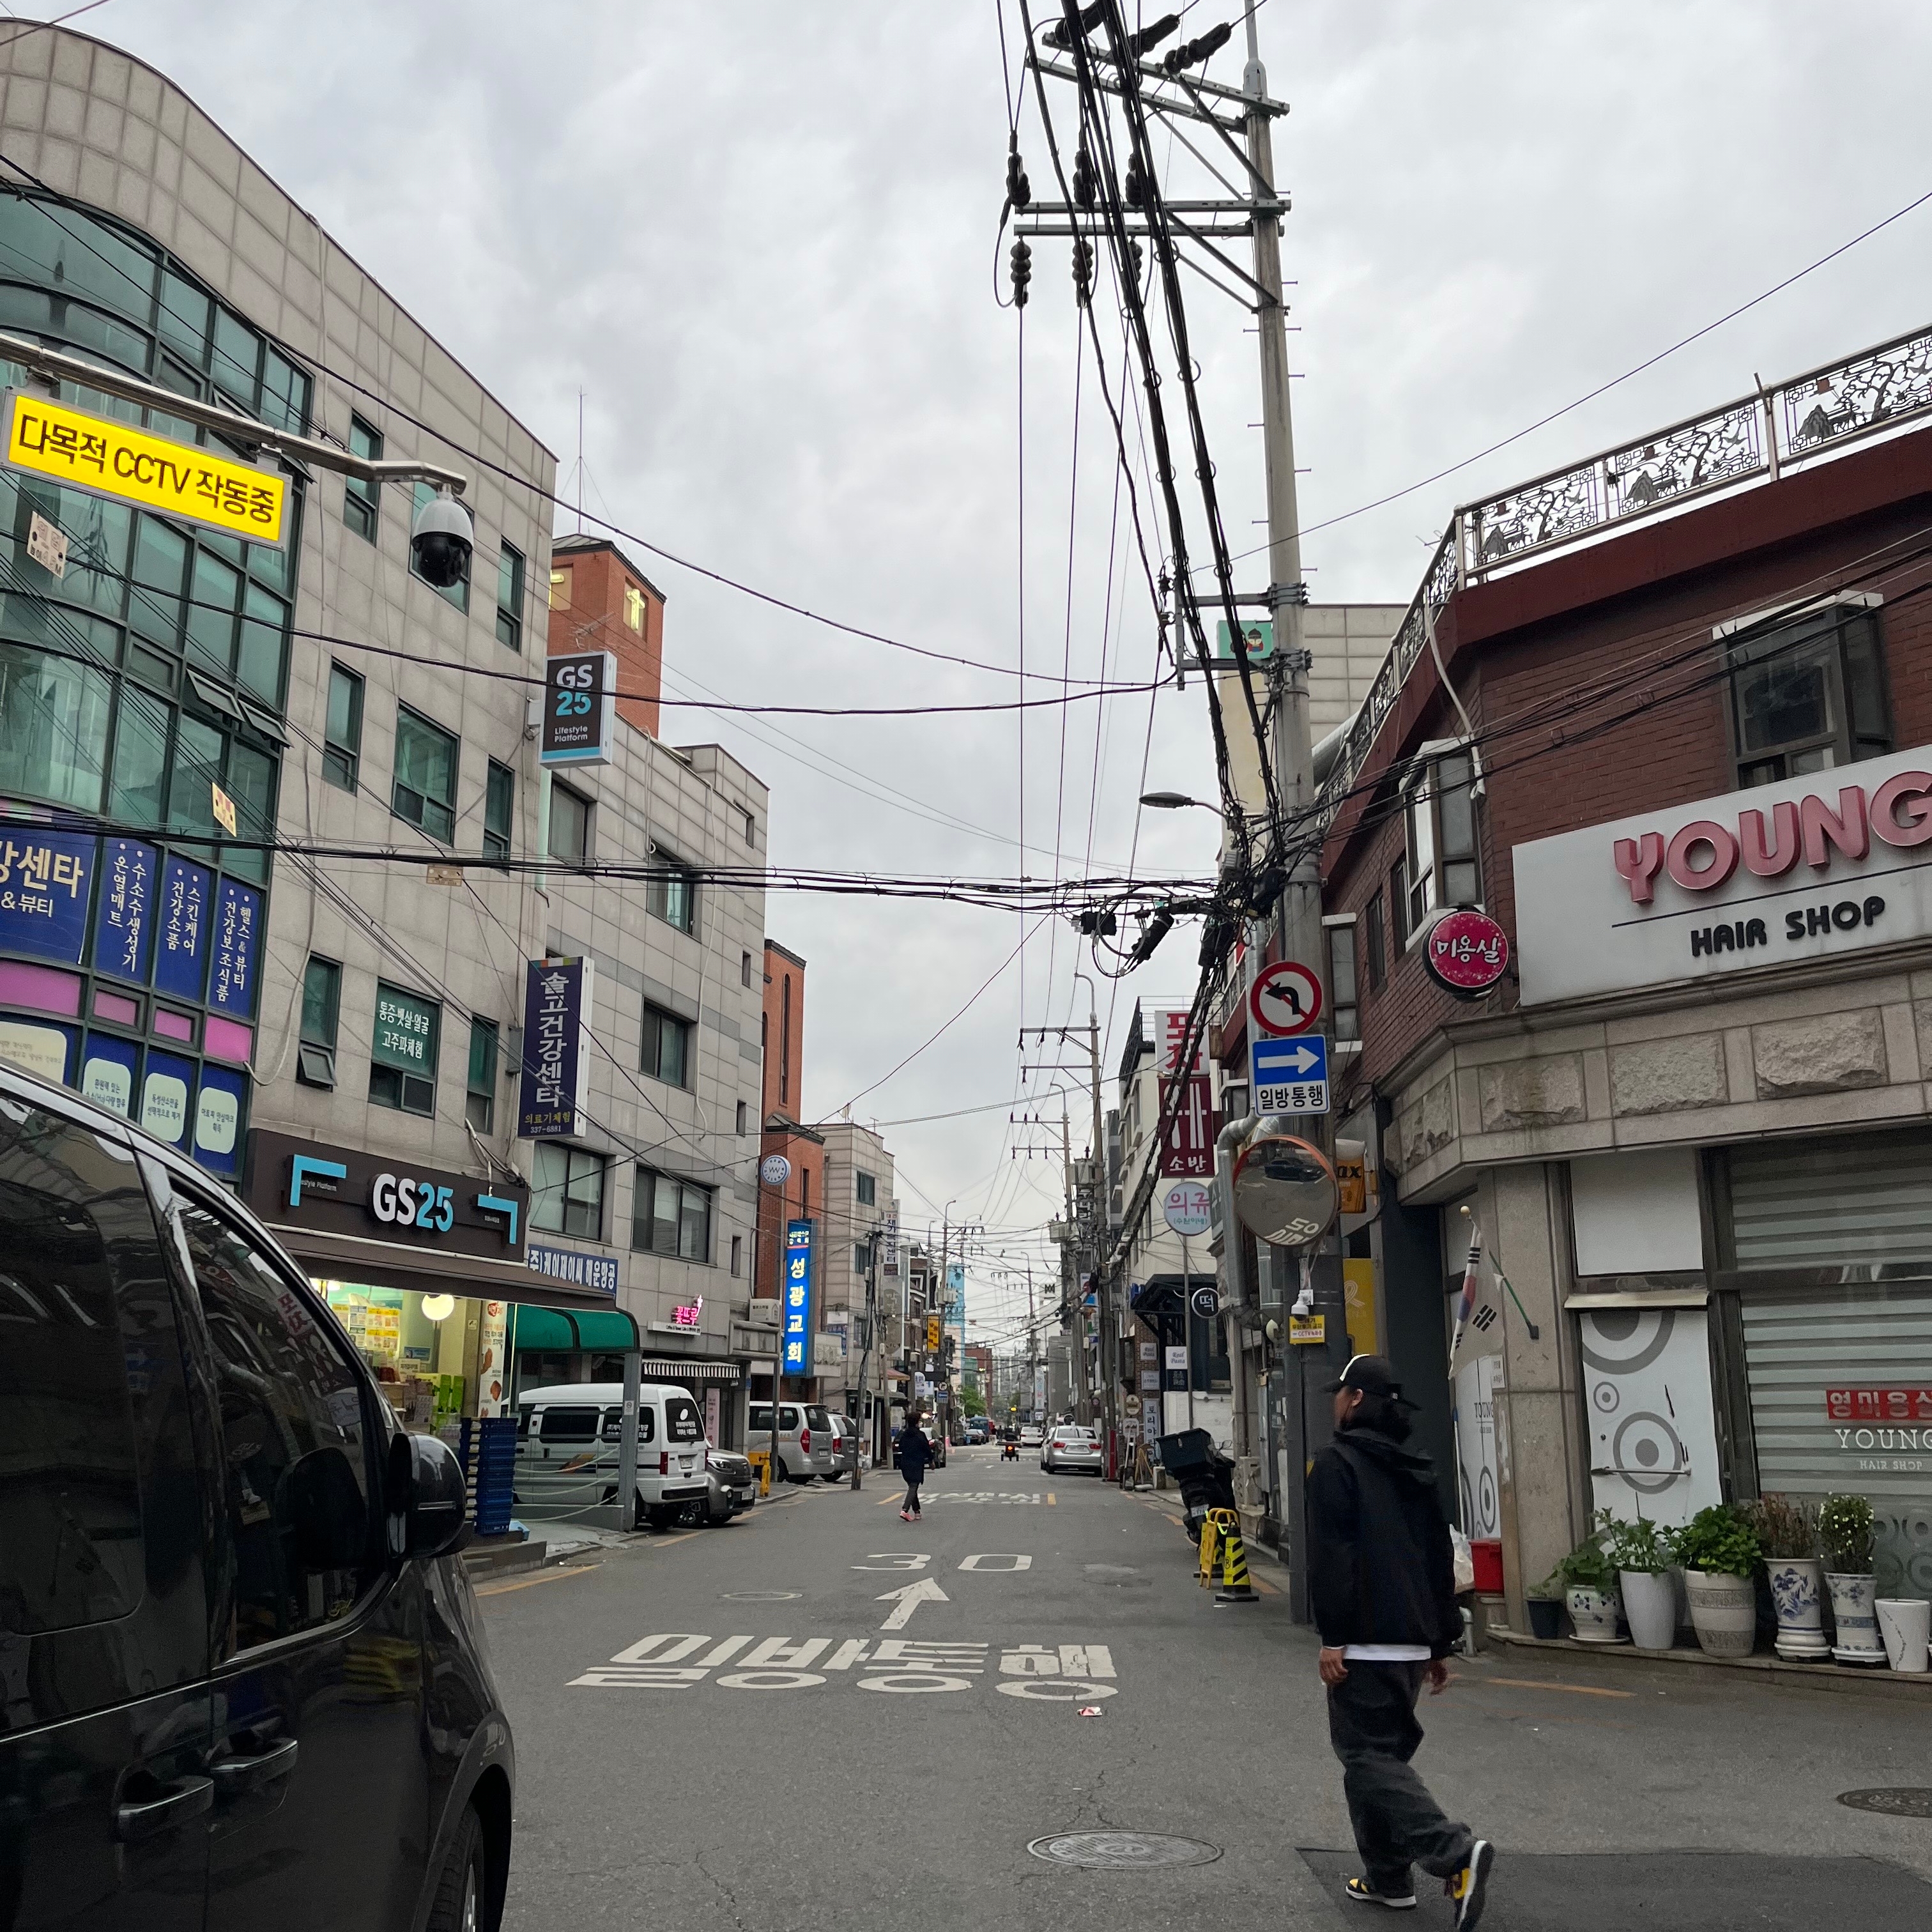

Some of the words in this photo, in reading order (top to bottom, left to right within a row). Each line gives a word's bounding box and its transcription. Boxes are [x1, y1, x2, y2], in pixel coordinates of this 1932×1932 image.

[19, 413, 106, 473] 다목적
[114, 446, 191, 494] CCTV
[196, 469, 275, 524] 작동중
[556, 664, 593, 688] GS
[556, 690, 592, 716] 25
[554, 725, 588, 735] Lifestyle
[554, 733, 588, 742] Platform
[107, 855, 130, 928] 온열매트
[122, 862, 147, 972] 수소수생성기
[165, 880, 185, 952] 건강소품
[182, 885, 201, 957] 스킨케어
[1690, 917, 1767, 958] HAIR
[1785, 895, 1886, 940] SHOP
[216, 901, 237, 1003] 건강보조식품
[1436, 935, 1500, 963] 미용실
[381, 1031, 423, 1059] 고주파체험
[535, 971, 570, 1108] 솔고건강센타
[1166, 1013, 1203, 1071] 포차
[1260, 1084, 1323, 1110] 일방통행
[525, 1111, 571, 1124] 의료기체험
[1169, 1155, 1207, 1173] 소반
[372, 1173, 454, 1232] GS25
[1167, 1191, 1210, 1216] 의류
[787, 1258, 805, 1363] 성광교회
[1199, 1294, 1214, 1312] 떡
[1860, 1460, 1887, 1470] HAIR
[850, 1552, 1033, 1572] 30
[564, 1632, 1119, 1701] 일방통행
